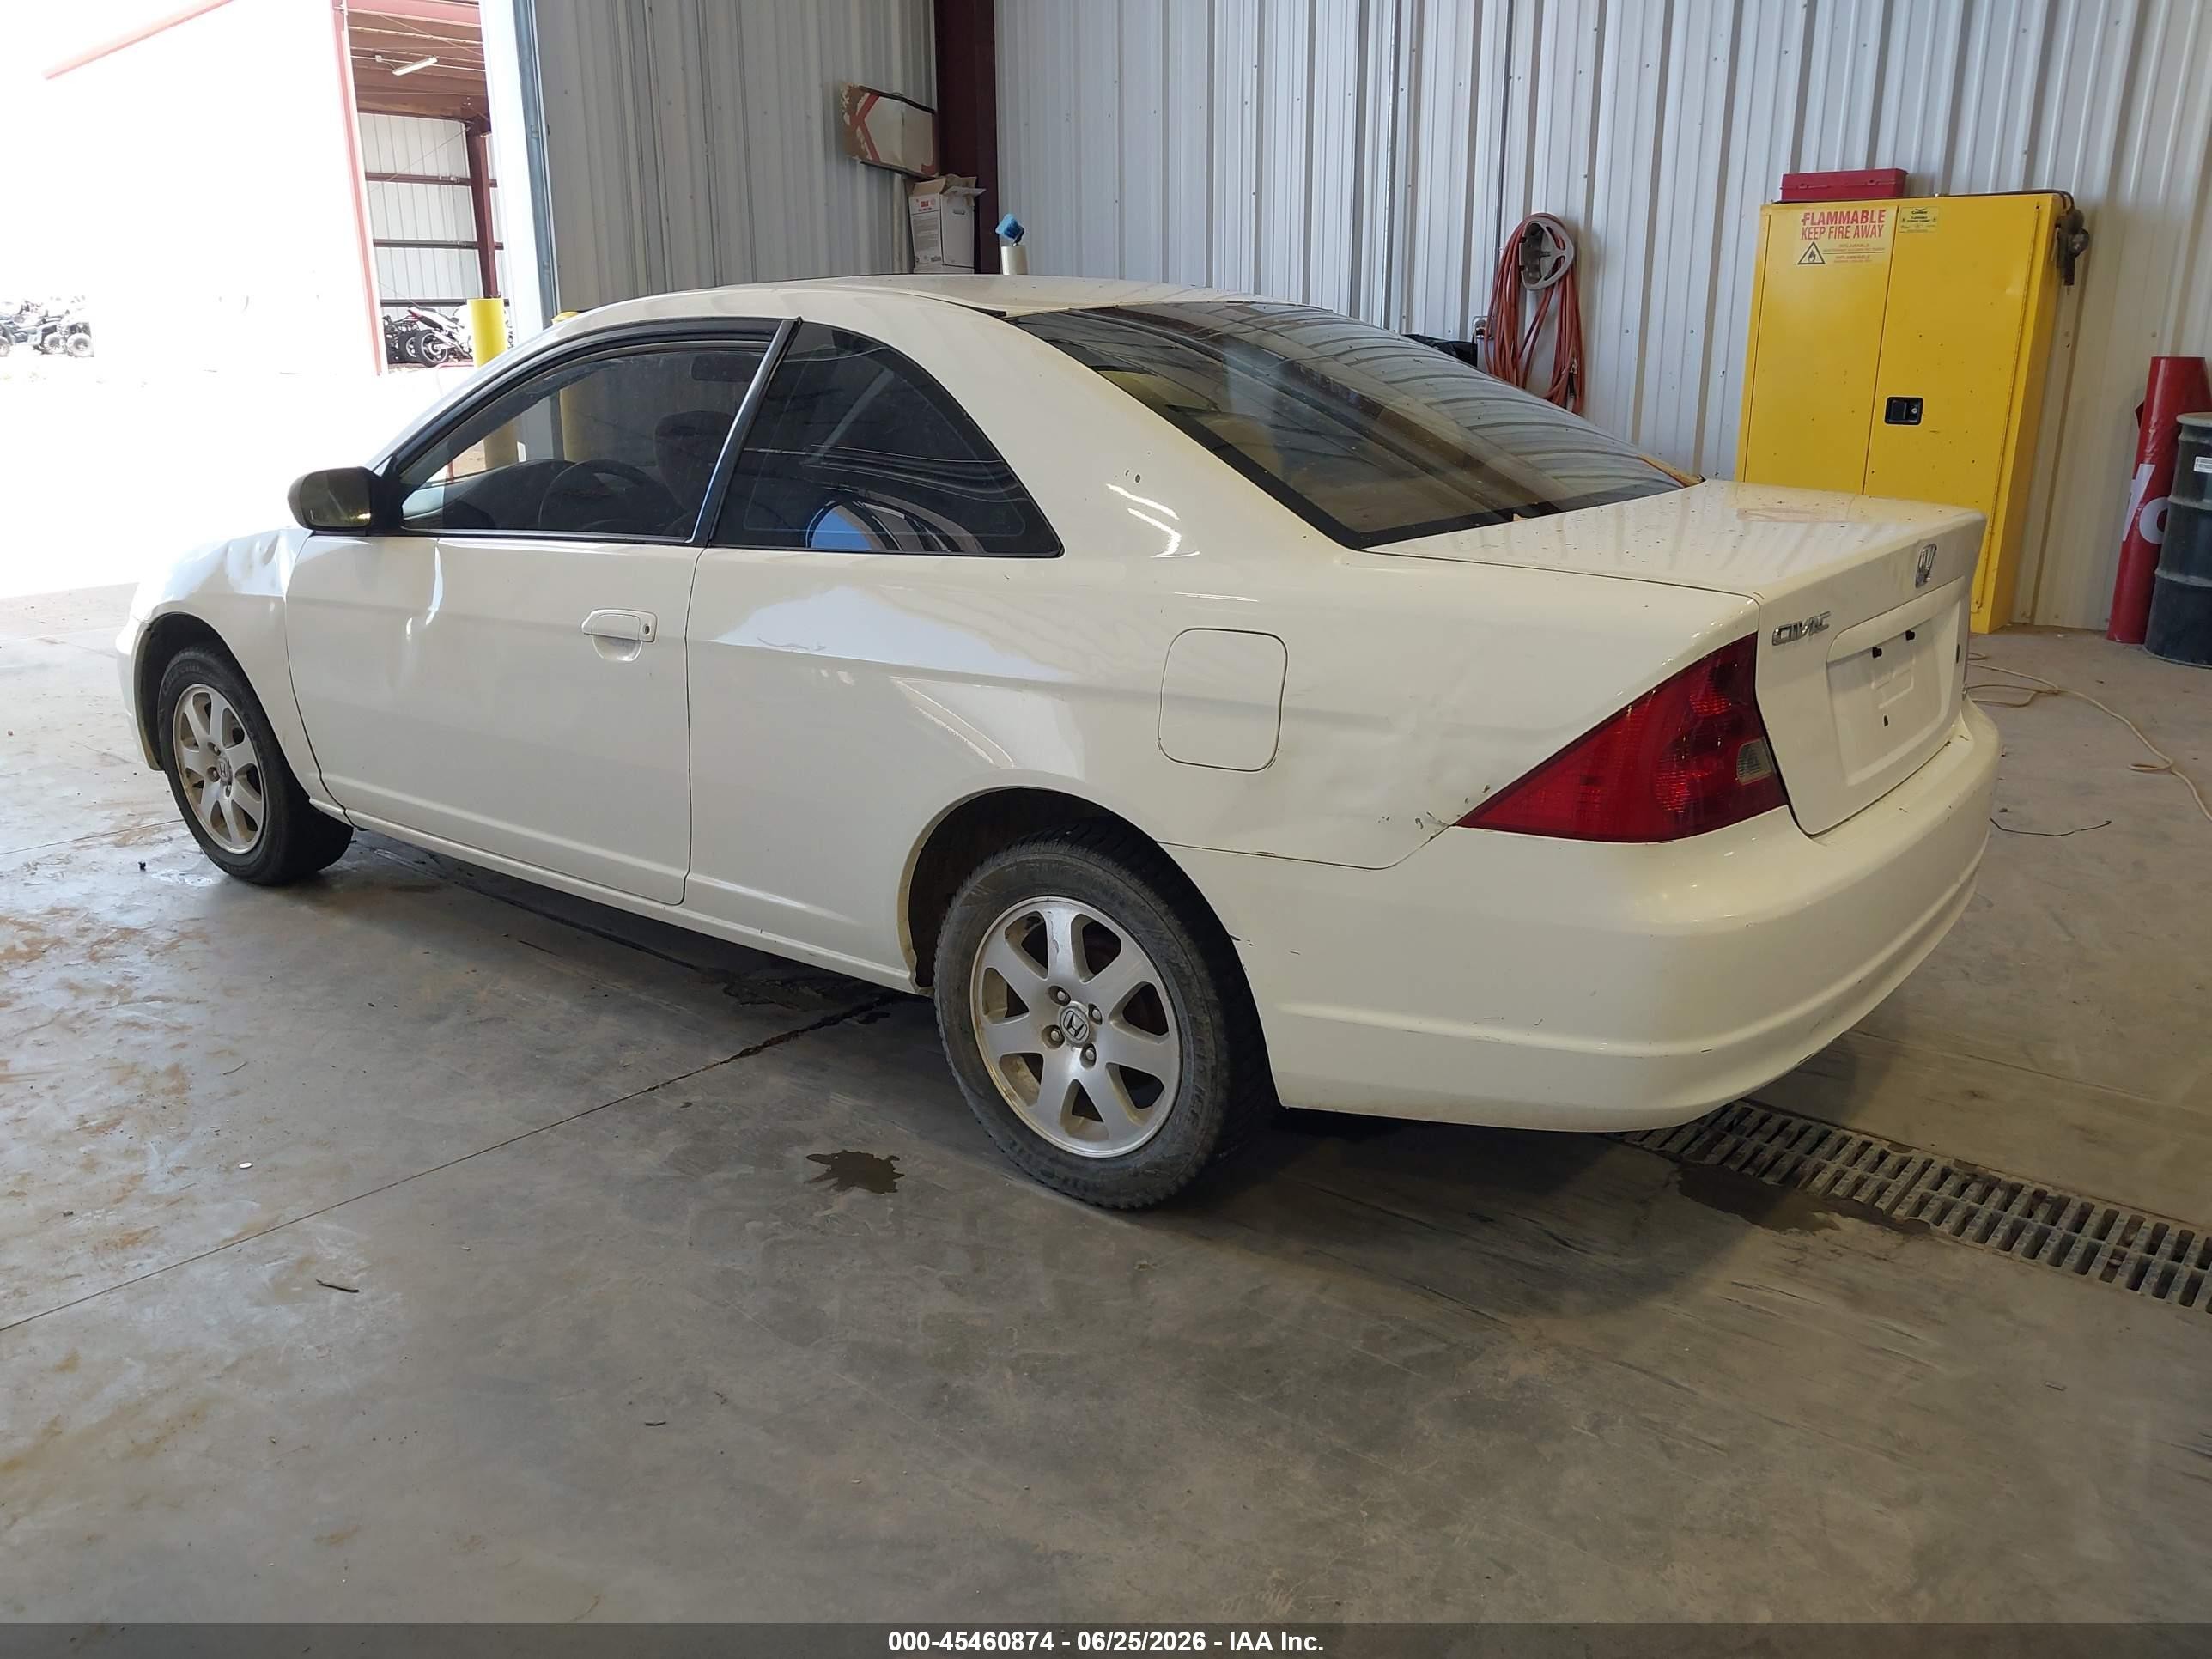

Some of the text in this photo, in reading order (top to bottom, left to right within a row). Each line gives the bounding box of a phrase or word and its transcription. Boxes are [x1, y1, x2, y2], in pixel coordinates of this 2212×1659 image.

[1802, 210, 1886, 225] FLAMMABLE
[1801, 226, 1826, 240] KEEP
[1828, 225, 1850, 239] FIRE
[1853, 224, 1884, 239] AWAY
[1772, 611, 1831, 646] CIVIC
